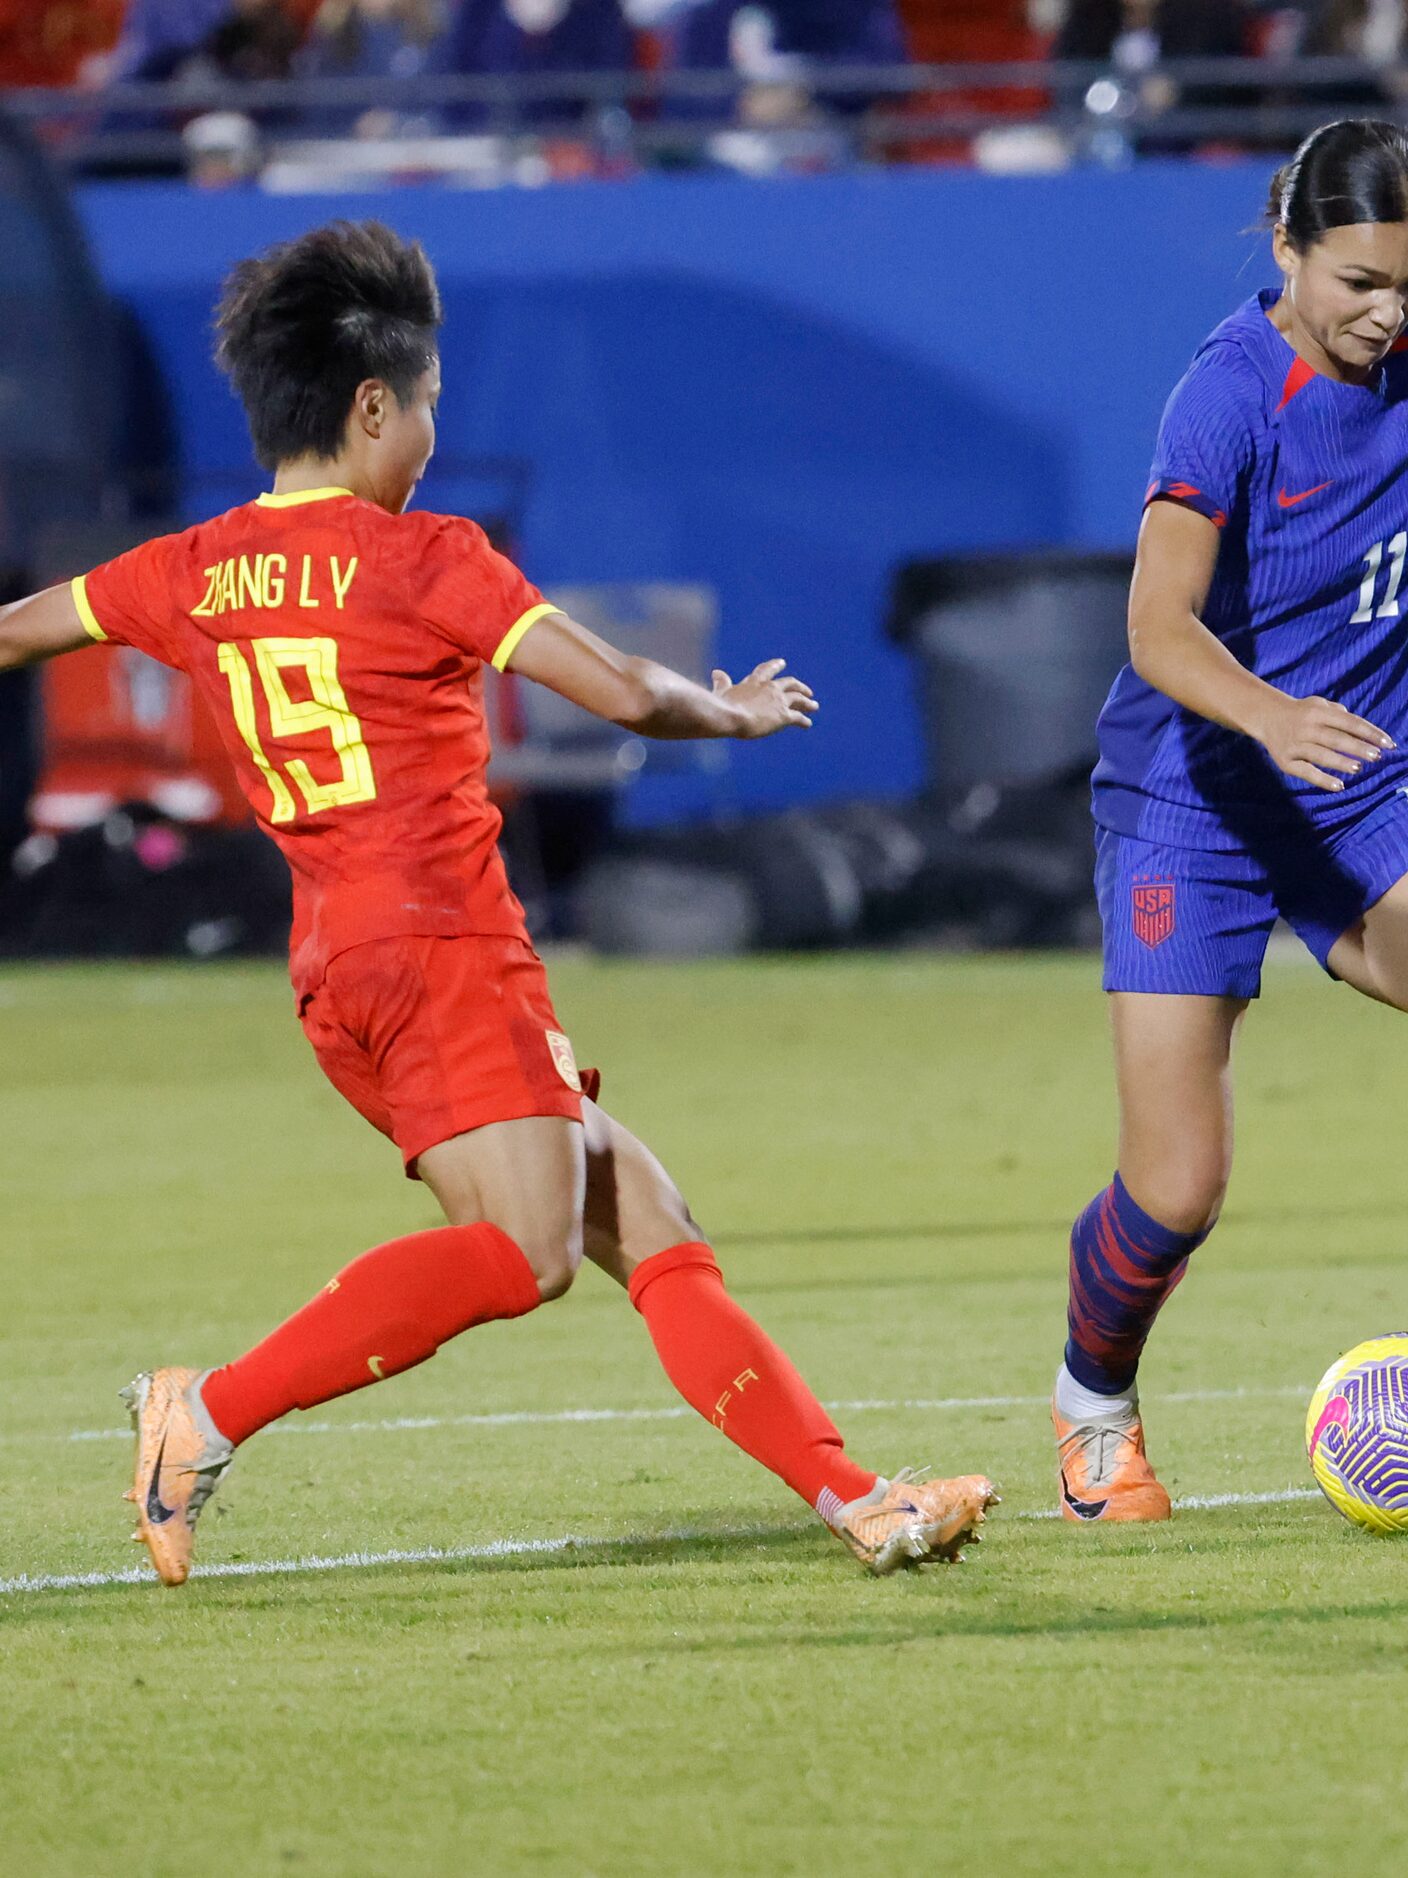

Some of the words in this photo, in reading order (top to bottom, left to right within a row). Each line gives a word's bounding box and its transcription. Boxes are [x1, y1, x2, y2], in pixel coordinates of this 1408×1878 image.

[190, 553, 287, 617] ZHANG
[298, 554, 359, 610] LY
[1349, 531, 1408, 624] 11
[217, 637, 377, 824] 19
[1134, 888, 1172, 914] USA
